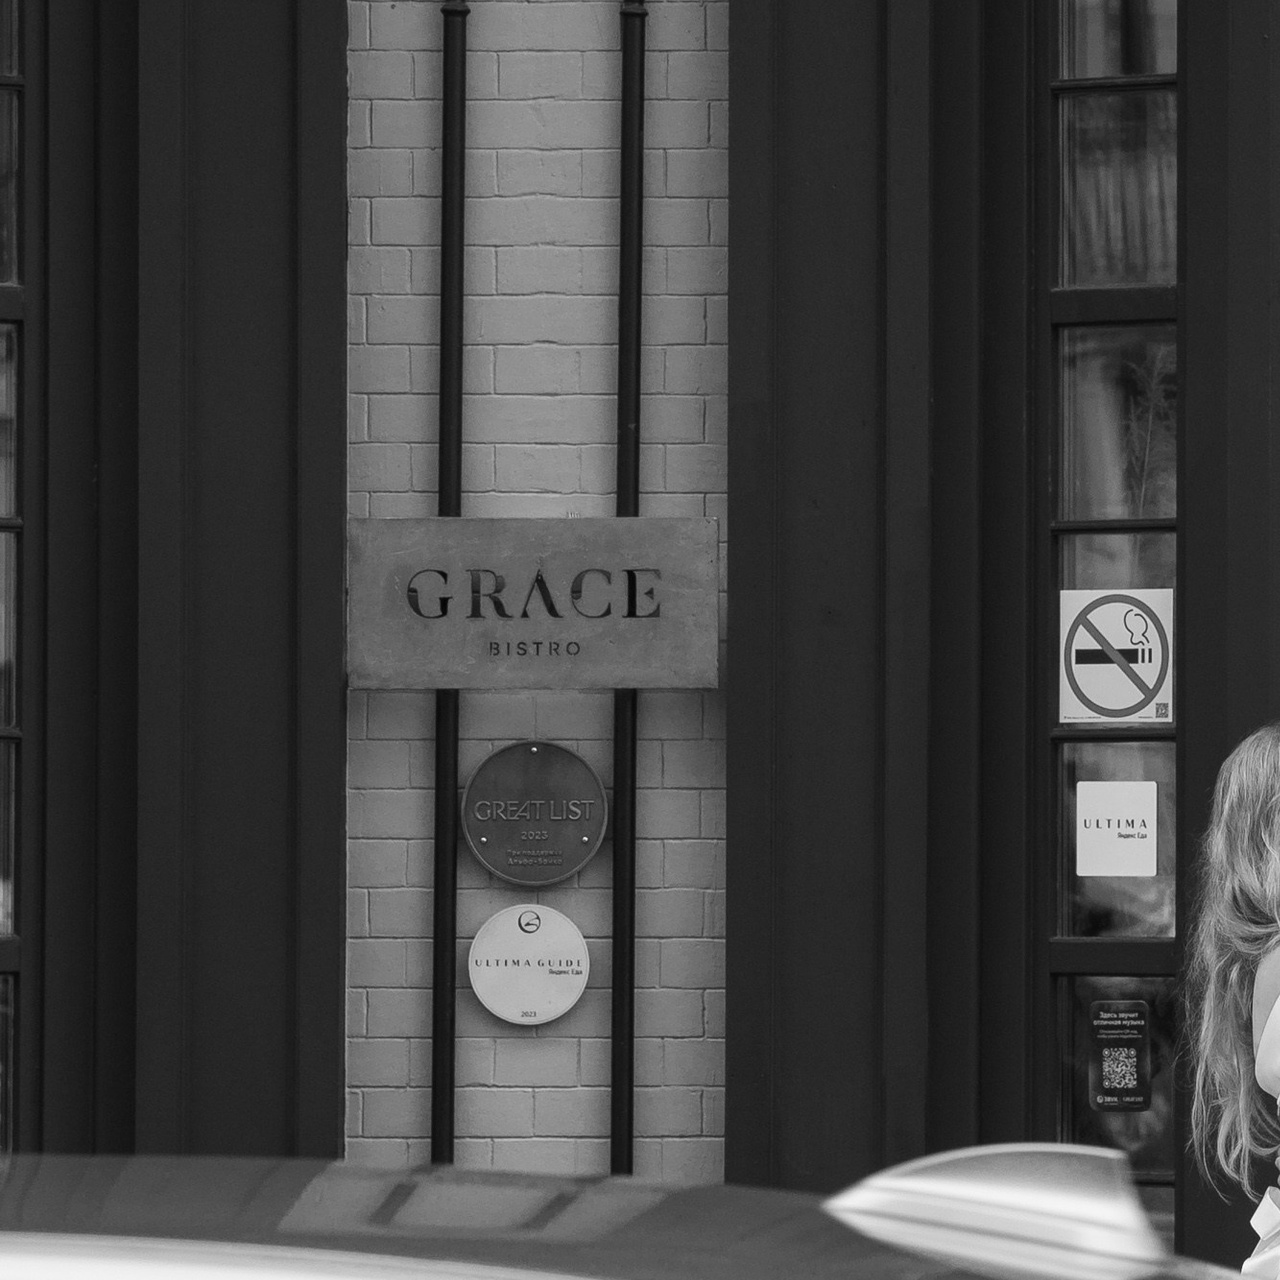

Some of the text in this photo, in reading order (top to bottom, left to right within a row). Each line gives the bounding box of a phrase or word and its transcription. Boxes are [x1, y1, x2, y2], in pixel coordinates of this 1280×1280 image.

[406, 567, 663, 620] GRACE
[488, 641, 582, 658] BISTRO
[474, 800, 595, 821] GREAT LIST
[1083, 818, 1148, 830] ULTIMA
[520, 830, 549, 841] 2023
[474, 959, 583, 968] ULTIMA GUIDE
